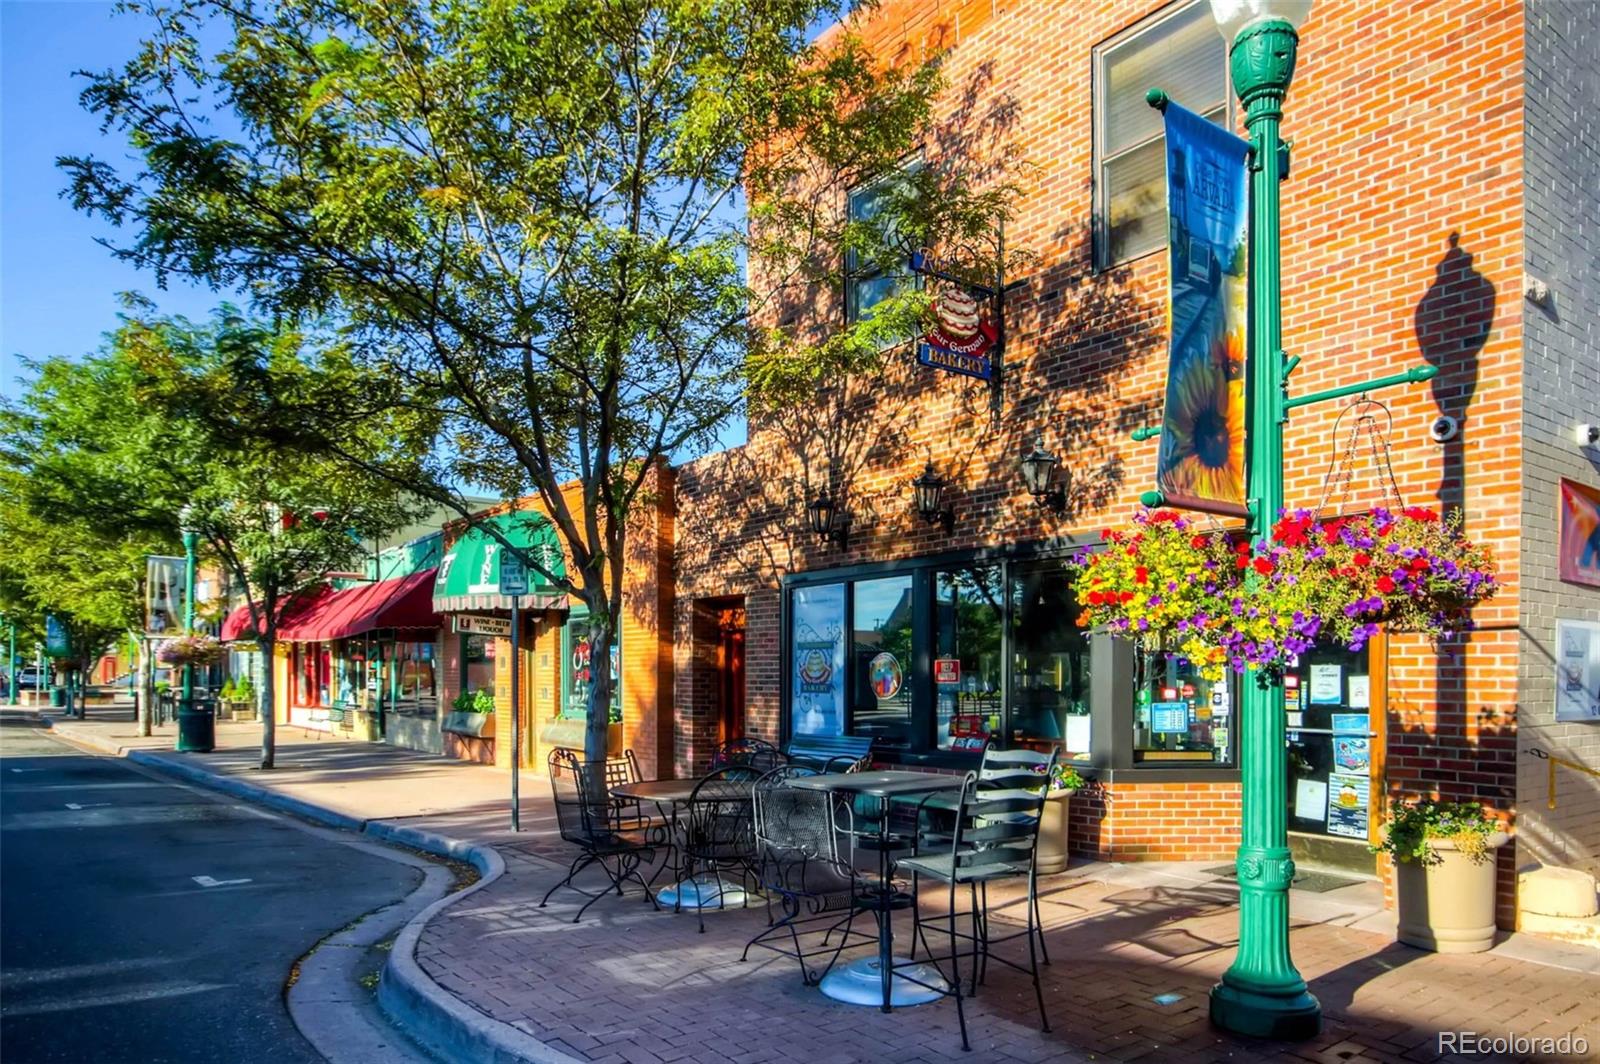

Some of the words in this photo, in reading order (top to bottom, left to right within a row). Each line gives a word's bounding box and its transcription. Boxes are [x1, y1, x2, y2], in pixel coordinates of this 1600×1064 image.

[949, 334, 985, 353] German
[929, 348, 984, 373] BAKERY
[473, 618, 490, 626] WINE
